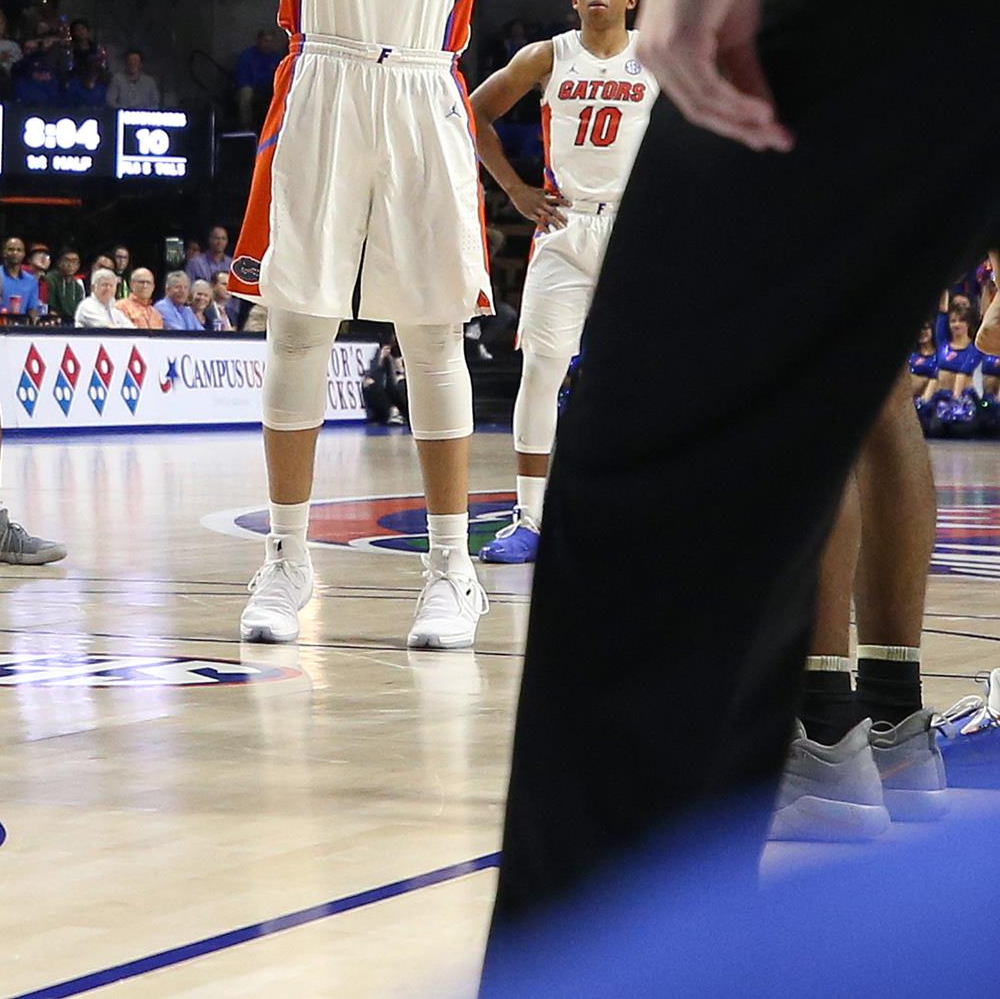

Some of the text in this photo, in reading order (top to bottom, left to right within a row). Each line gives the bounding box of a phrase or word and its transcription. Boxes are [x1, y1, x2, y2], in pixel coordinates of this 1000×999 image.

[557, 80, 646, 103] GATORS
[24, 117, 100, 150] 8:04
[574, 106, 622, 147] 10
[136, 129, 169, 155] 10
